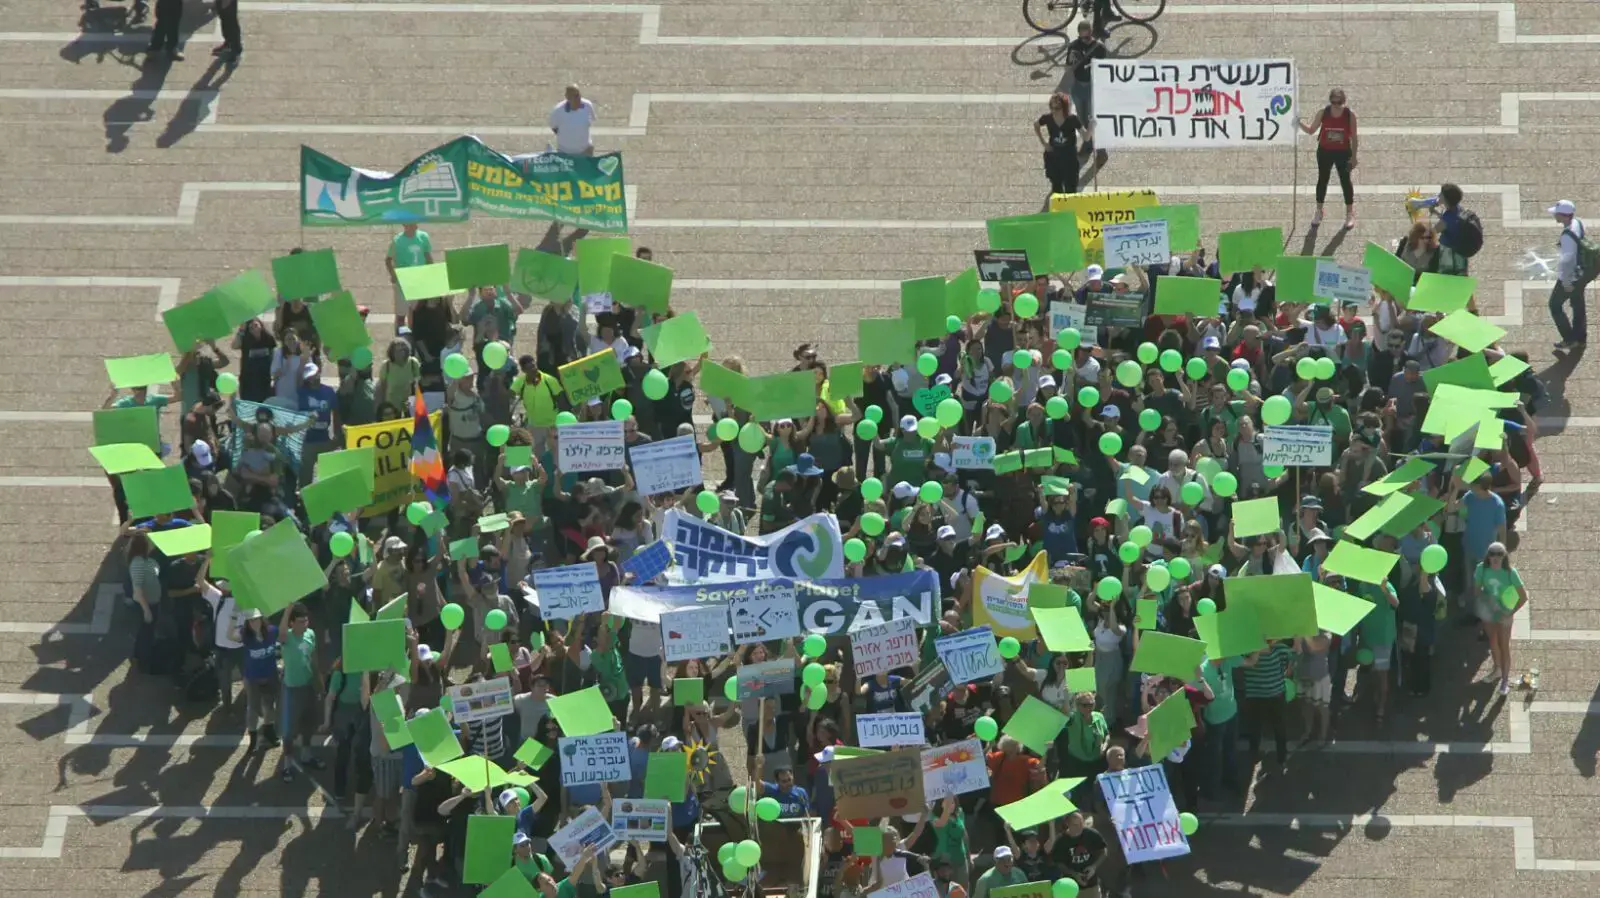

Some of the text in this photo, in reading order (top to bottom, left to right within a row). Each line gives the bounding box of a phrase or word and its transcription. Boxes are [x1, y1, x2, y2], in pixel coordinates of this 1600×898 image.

[1098, 63, 1179, 83] הבשר
[1096, 108, 1280, 140] לנו את המחר
[578, 180, 621, 201] מים
[1088, 210, 1135, 224] תקדמו
[356, 427, 412, 449] COA
[374, 452, 408, 477] ILL
[676, 519, 769, 558] מגמה
[675, 544, 768, 577] ירוקה
[696, 581, 859, 602] Save the Planet
[803, 592, 931, 635] GAN
[854, 633, 914, 656] חיפה אזור
[595, 737, 624, 745] אוהבים
[864, 723, 920, 739] טבעונות!
[580, 746, 620, 756] הסביבה
[587, 756, 626, 766] עוברים
[563, 768, 621, 784] לטבעונות
[1100, 767, 1167, 800] הסביבה
[1121, 817, 1185, 852] אנחנו!
